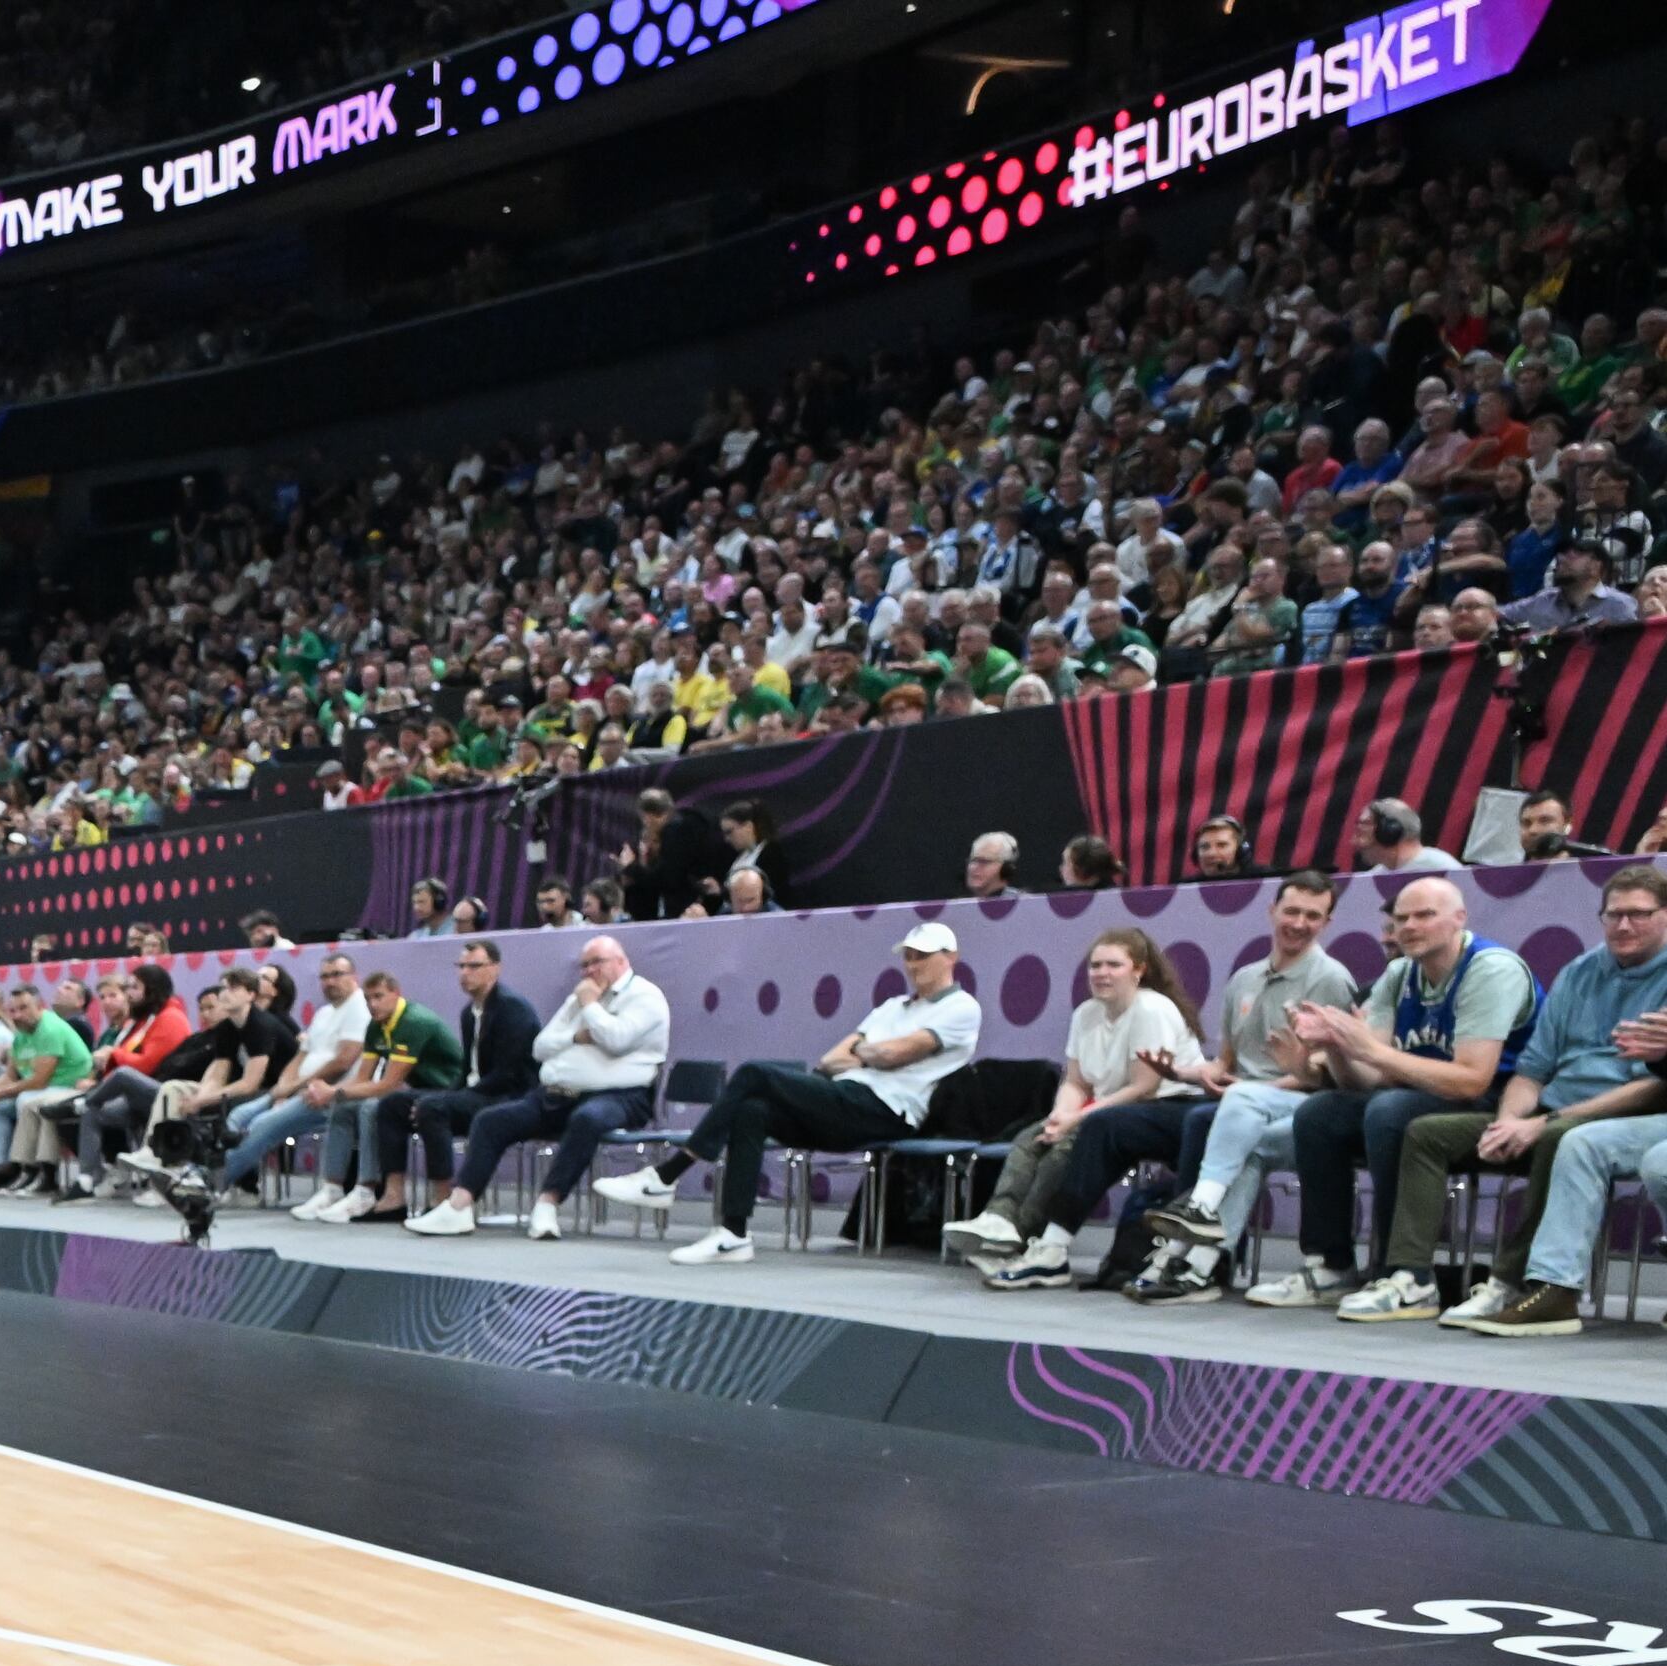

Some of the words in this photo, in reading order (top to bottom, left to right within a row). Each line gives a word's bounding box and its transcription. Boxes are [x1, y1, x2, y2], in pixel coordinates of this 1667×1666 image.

[142, 135, 257, 212] YOUR
[273, 83, 398, 176] MARK
[1068, 0, 1482, 208] #EUROBASKET
